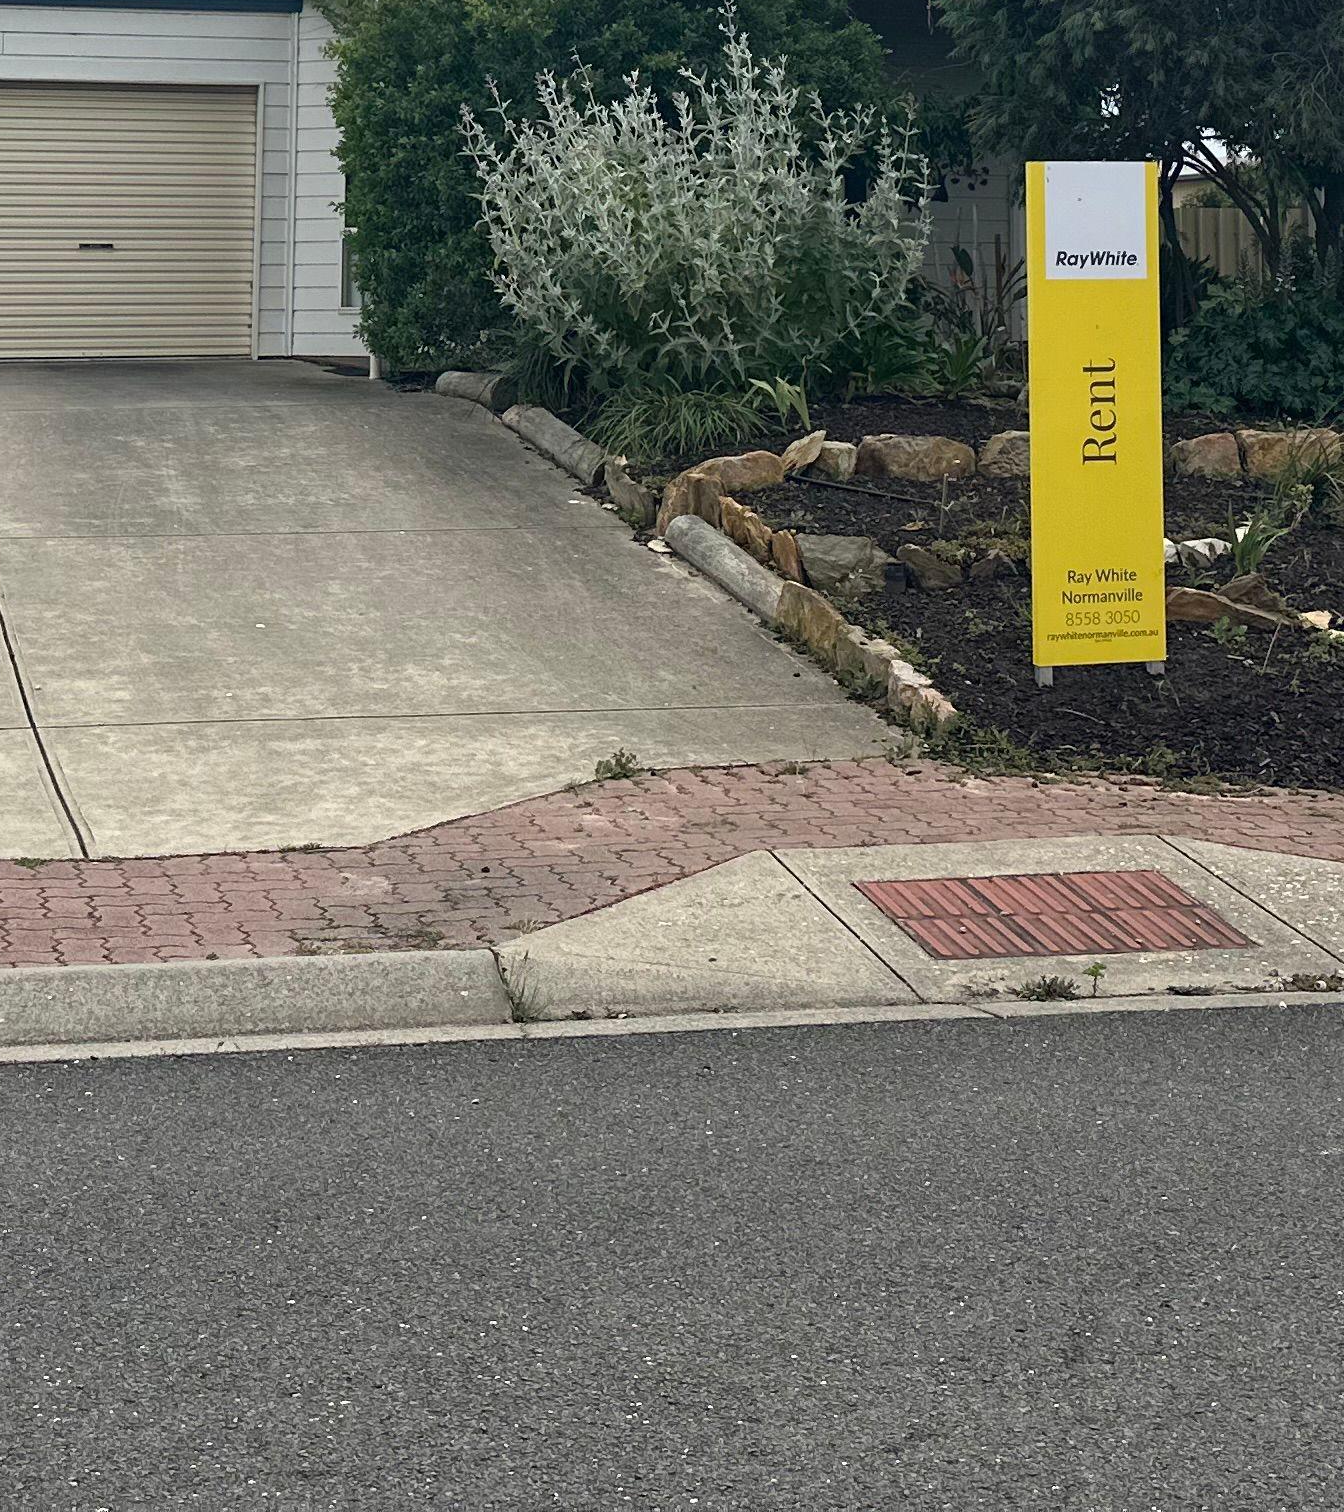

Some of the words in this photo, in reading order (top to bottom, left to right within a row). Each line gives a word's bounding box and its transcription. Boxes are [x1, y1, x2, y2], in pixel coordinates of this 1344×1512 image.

[1082, 357, 1118, 466] Rent
[1067, 569, 1093, 586] Ray
[1095, 568, 1138, 583] White
[1061, 588, 1144, 605] Normanville
[1065, 611, 1101, 627] 8558
[1105, 609, 1141, 625] 3050
[1047, 629, 1159, 642] raywhitenormanville.com.au
